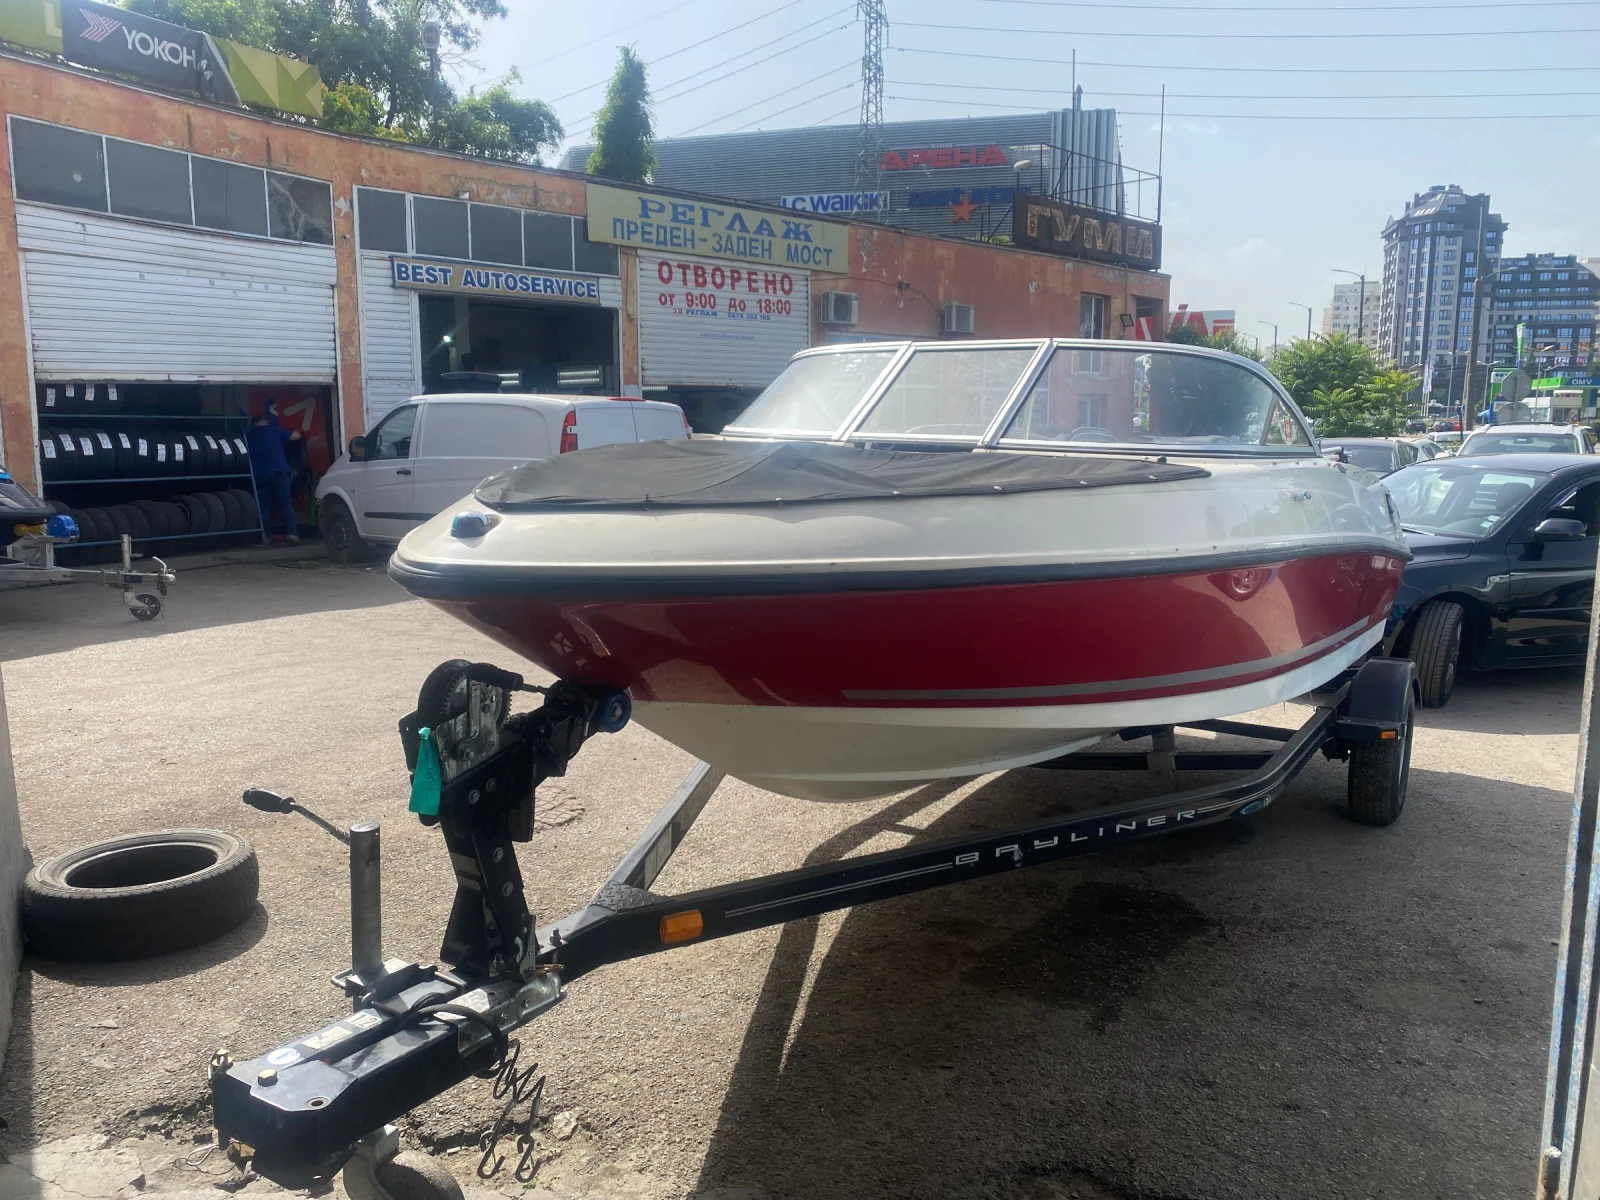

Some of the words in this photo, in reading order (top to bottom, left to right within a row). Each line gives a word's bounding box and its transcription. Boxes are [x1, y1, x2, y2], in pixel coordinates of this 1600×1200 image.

[638, 196, 813, 242] РЕГЛАЖ
[1027, 203, 1153, 260] ГУМИ
[786, 243, 833, 266] МОСТ
[395, 262, 452, 286] BEST
[462, 268, 599, 299] AUTOSERVICE
[658, 259, 794, 296] ОТВОРЕНО
[685, 292, 717, 309] 9:00
[756, 298, 792, 315] 18:00
[685, 309, 718, 317] РЕГЛАЖ
[955, 810, 1195, 865] BAYLINER
